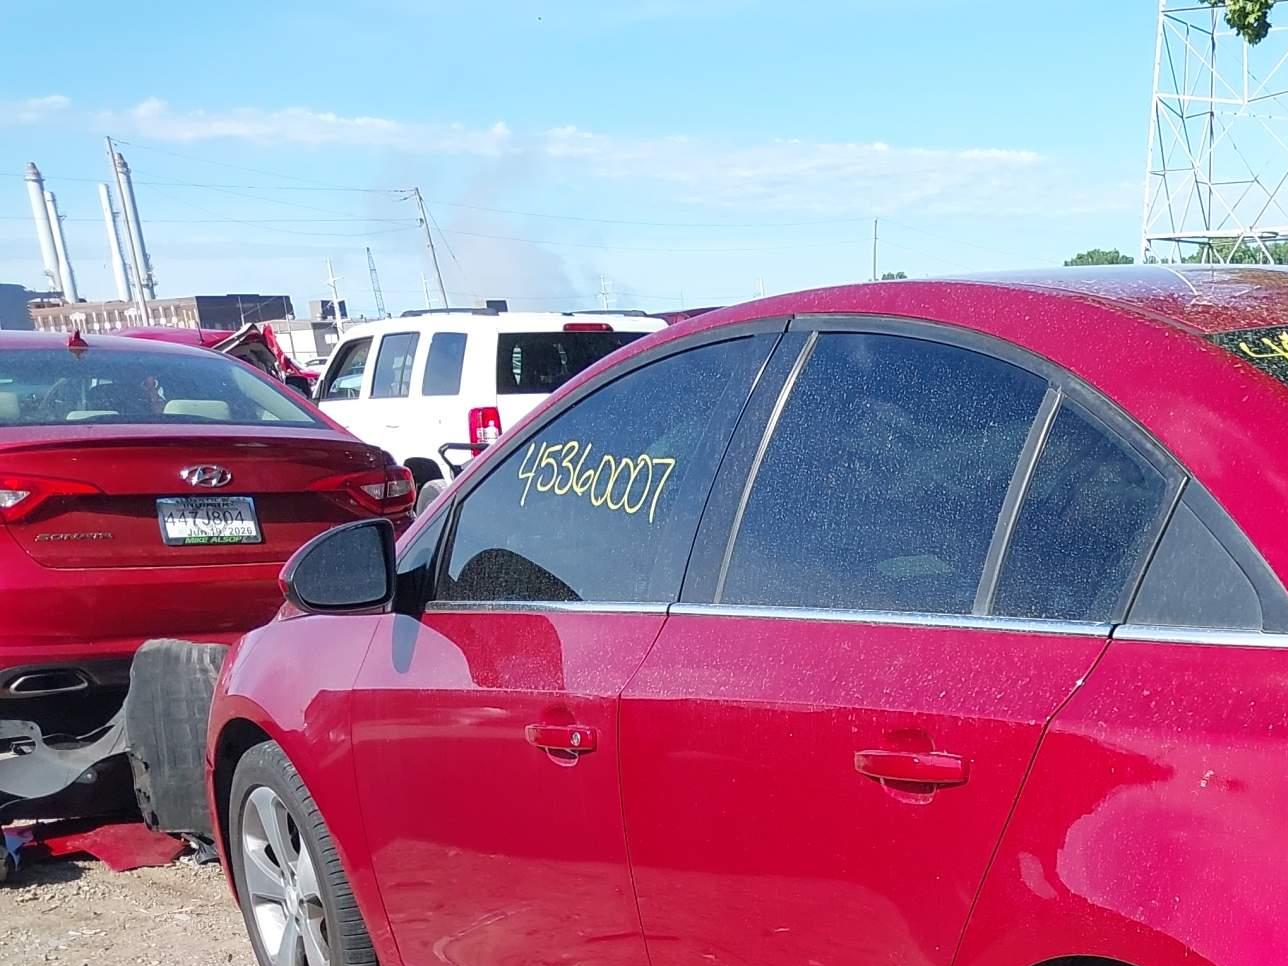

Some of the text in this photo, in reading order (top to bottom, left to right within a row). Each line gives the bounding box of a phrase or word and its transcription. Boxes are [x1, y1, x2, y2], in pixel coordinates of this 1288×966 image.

[518, 440, 676, 523] 45360007
[165, 510, 244, 526] 447J804
[228, 526, 252, 535] 2026
